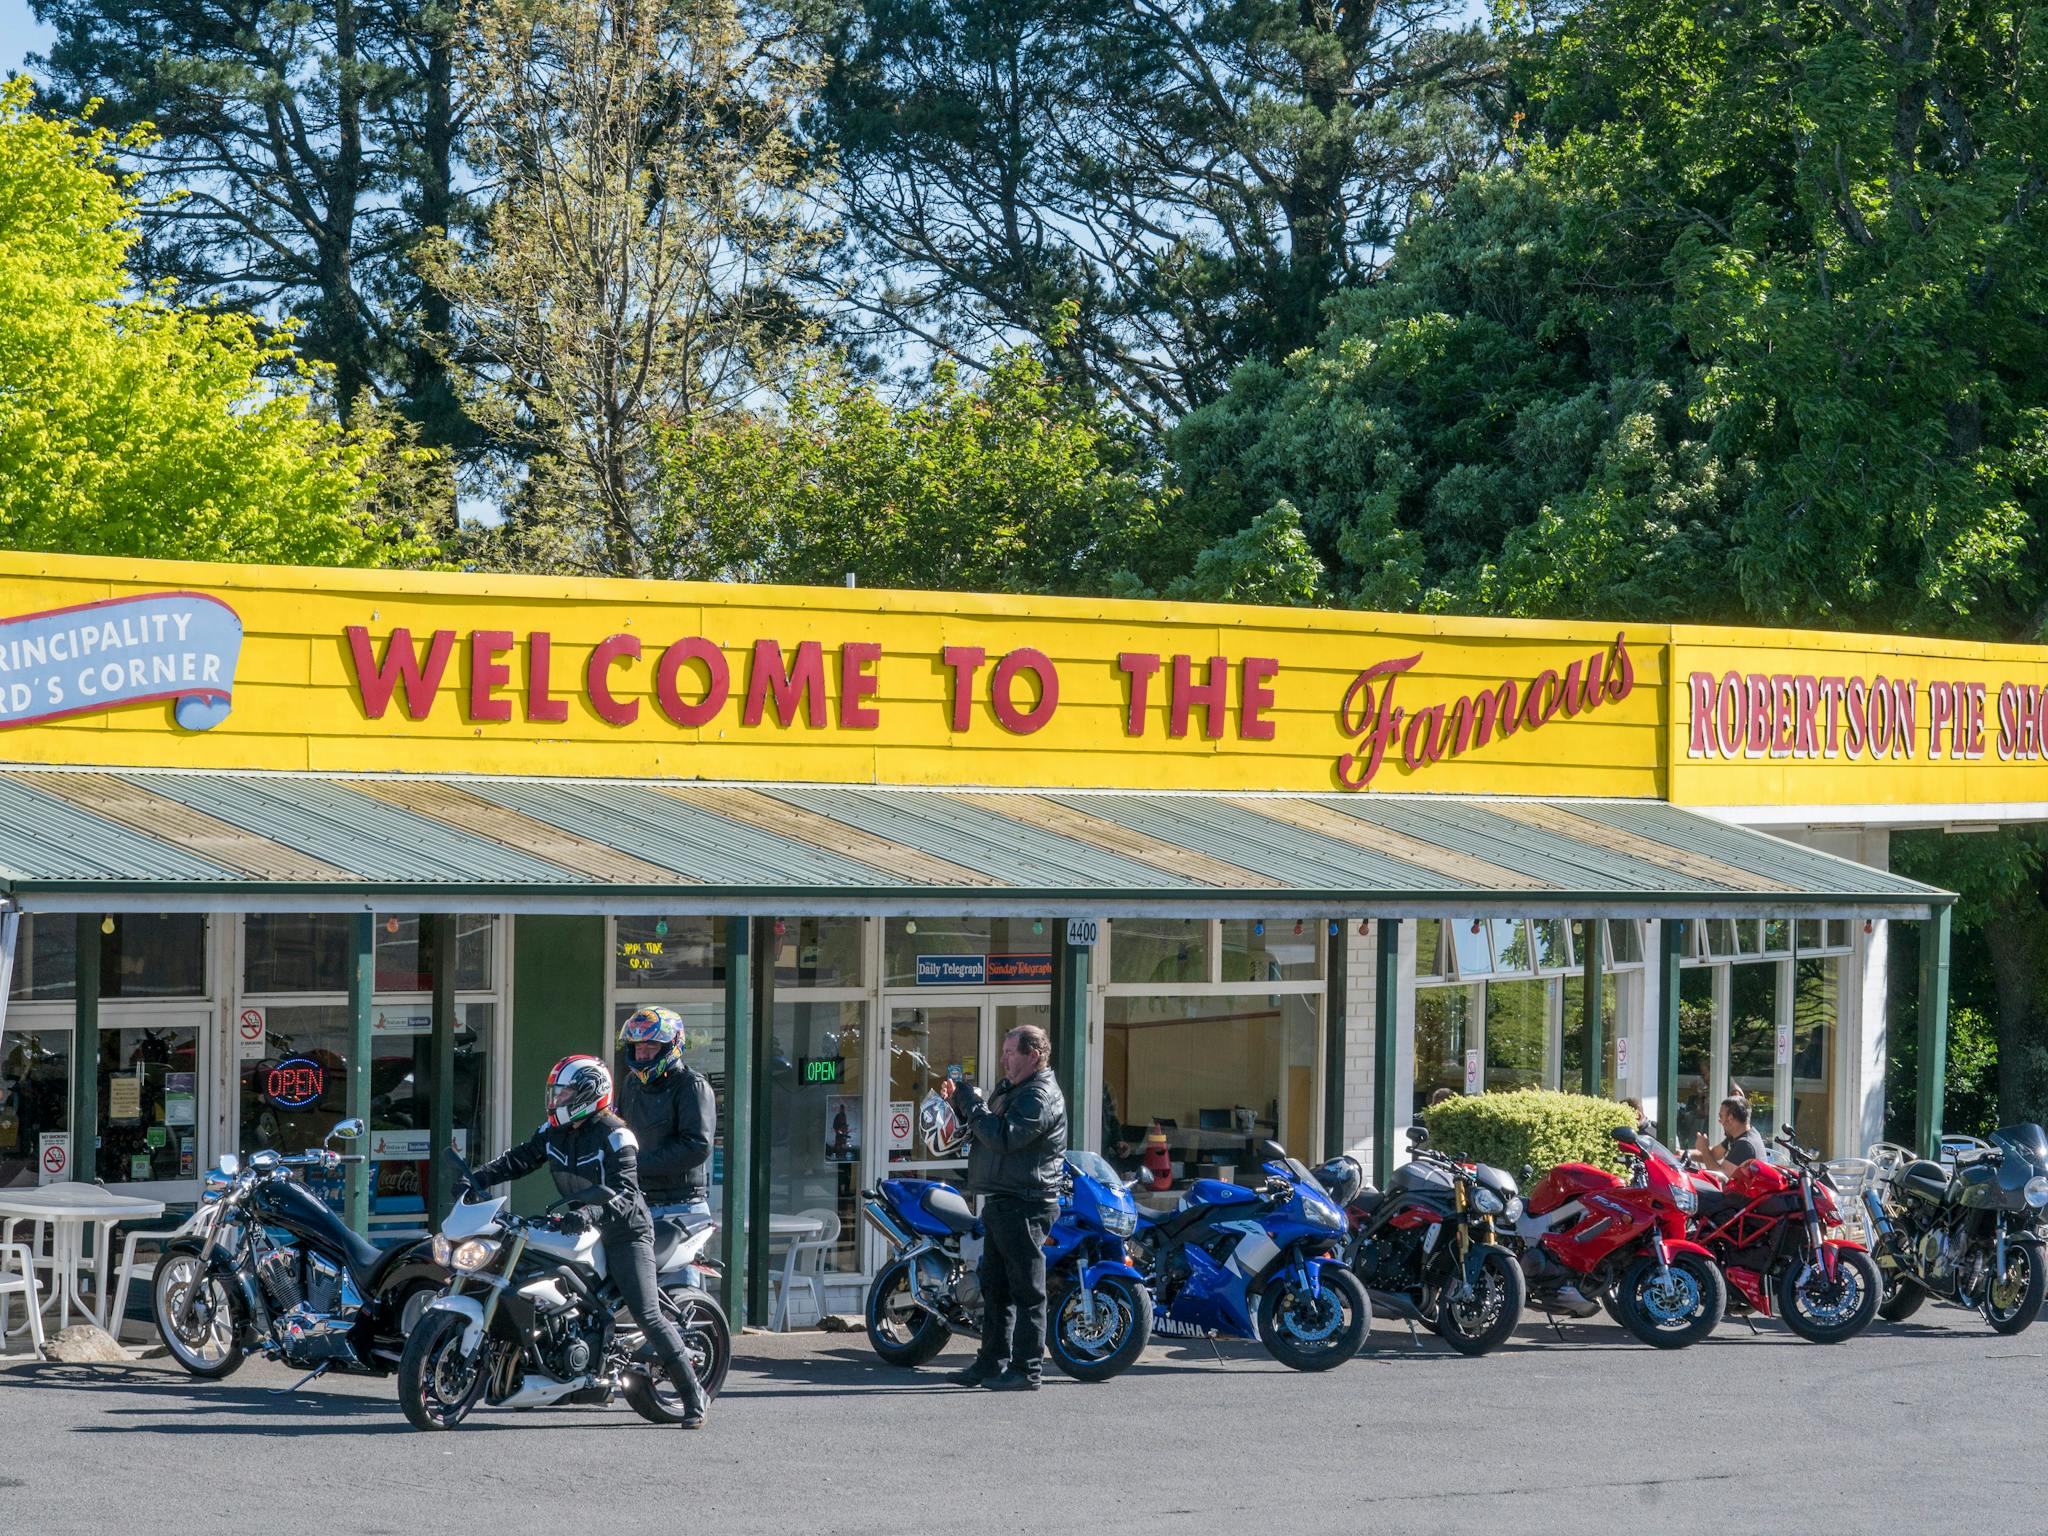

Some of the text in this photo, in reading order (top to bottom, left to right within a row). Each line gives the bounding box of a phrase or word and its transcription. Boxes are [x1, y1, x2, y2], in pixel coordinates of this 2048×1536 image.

[78, 653, 221, 696] CORNER
[345, 625, 1279, 740] WELCOME TO THE
[1338, 631, 1634, 789] Famous
[1688, 671, 1917, 760] ROBERTSON
[1928, 680, 1986, 760] PIE
[1070, 922, 1097, 942] 4400
[919, 963, 983, 978] Daily Telegraph
[989, 961, 1052, 978] Sunday Telegraph
[268, 1068, 323, 1097] OPEN
[807, 1061, 835, 1081] OPEN
[1152, 1316, 1205, 1337] YAMAHA
